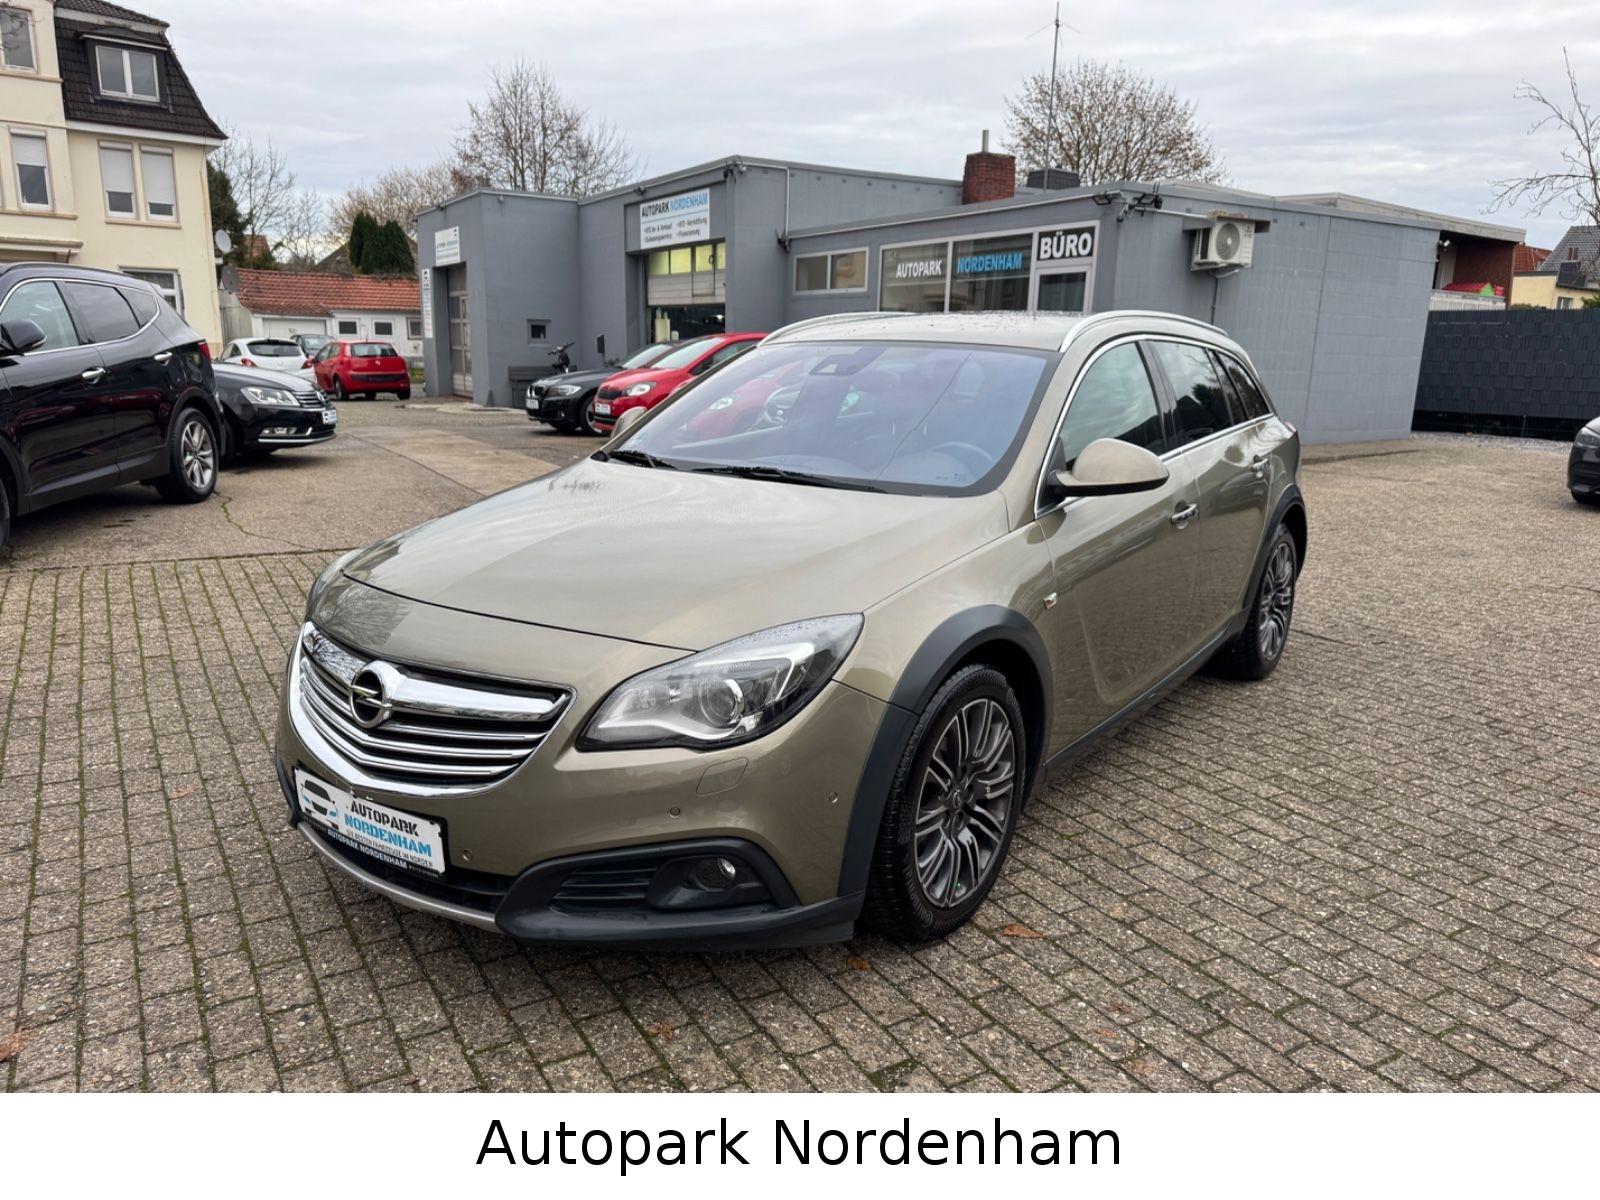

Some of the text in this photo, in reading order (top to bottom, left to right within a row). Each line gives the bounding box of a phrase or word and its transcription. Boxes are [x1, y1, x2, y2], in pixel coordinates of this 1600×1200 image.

[641, 192, 708, 217] AUTOPARK NORDENHAM
[1039, 231, 1092, 260] BÜRO
[896, 252, 1023, 278] AUTOPARK NORDENHAM
[350, 800, 419, 837] AUTOPARK
[327, 828, 408, 870] AUTOPARK NORDENHAM
[344, 813, 433, 858] NORDENHAM
